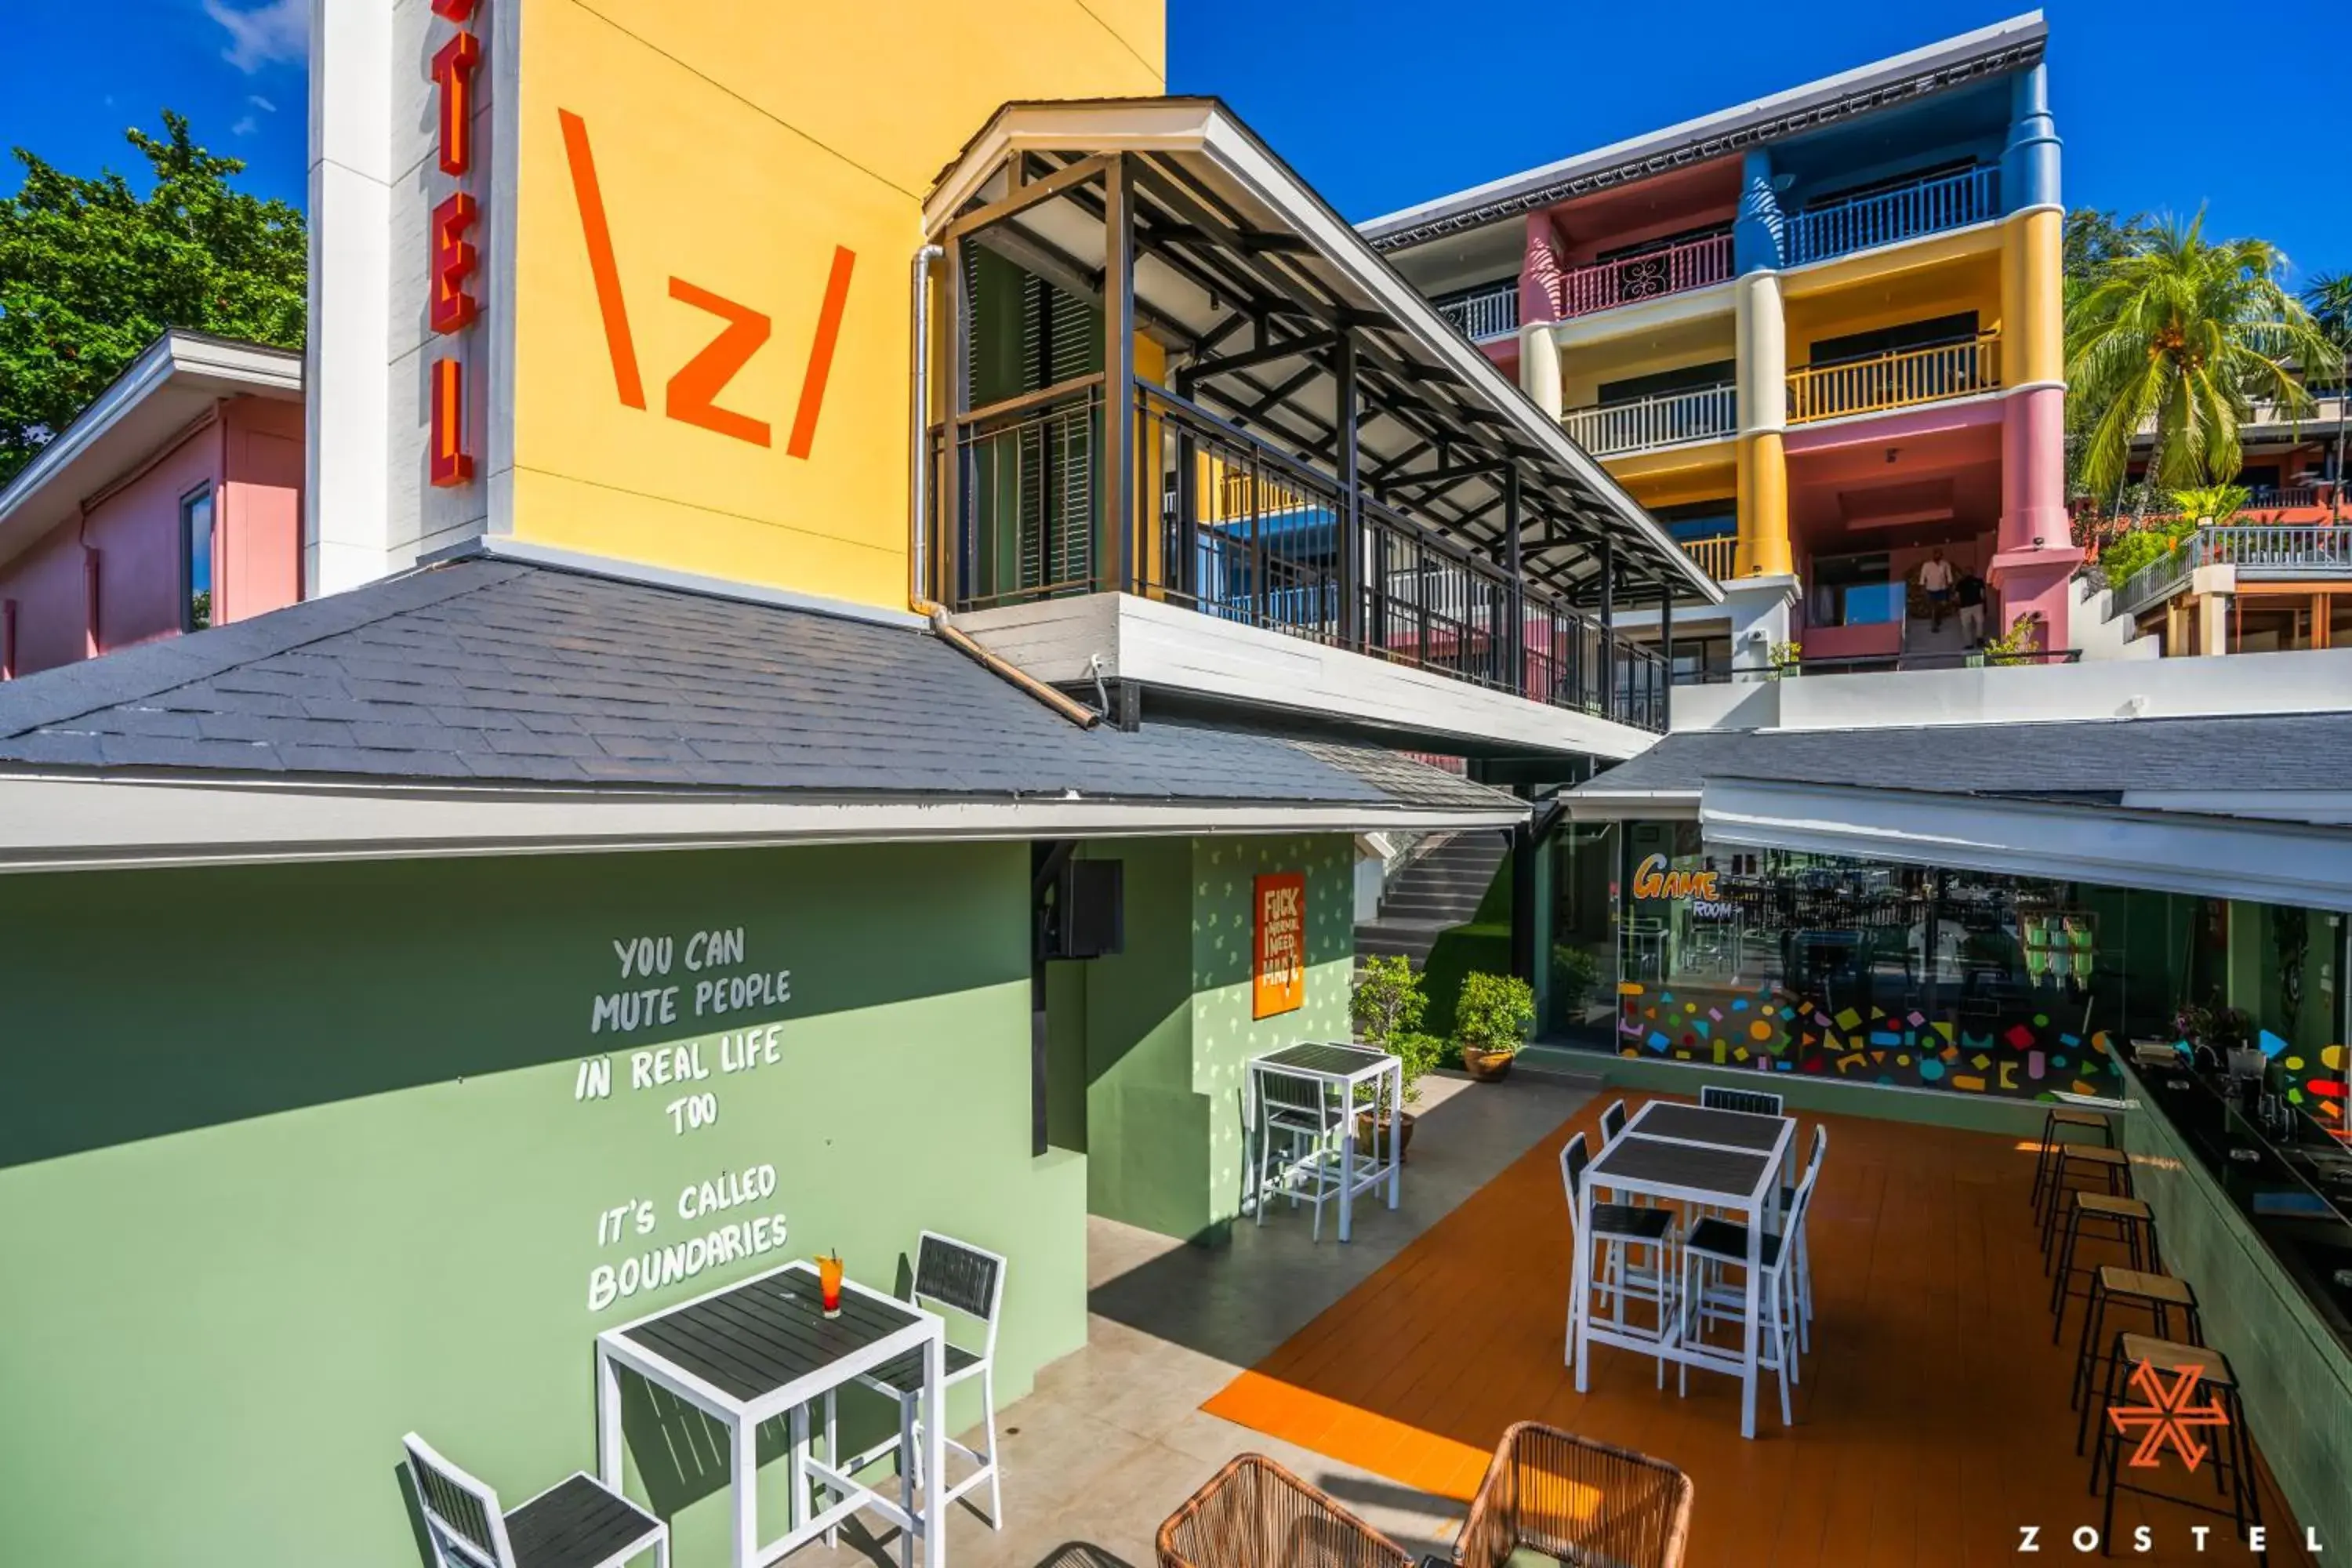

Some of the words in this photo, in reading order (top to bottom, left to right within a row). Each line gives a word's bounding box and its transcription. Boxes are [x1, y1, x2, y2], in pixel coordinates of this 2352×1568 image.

[430, 0, 479, 488] TEL
[1265, 887, 1300, 922] FUCK
[1693, 902, 1732, 918] ROOM
[614, 935, 673, 978] YOU
[685, 927, 745, 971] CAN
[1270, 935, 1295, 956] NEED
[591, 985, 679, 1033] MUTE
[695, 970, 792, 1016] PEOPLE
[575, 1054, 612, 1101] IN
[631, 1042, 710, 1091] REAL
[721, 1025, 783, 1073] LIFE
[666, 1092, 717, 1134] TOO
[598, 1199, 655, 1247] IT'S
[679, 1163, 777, 1220] CALLED
[588, 1214, 788, 1312] BOUNDARIES
